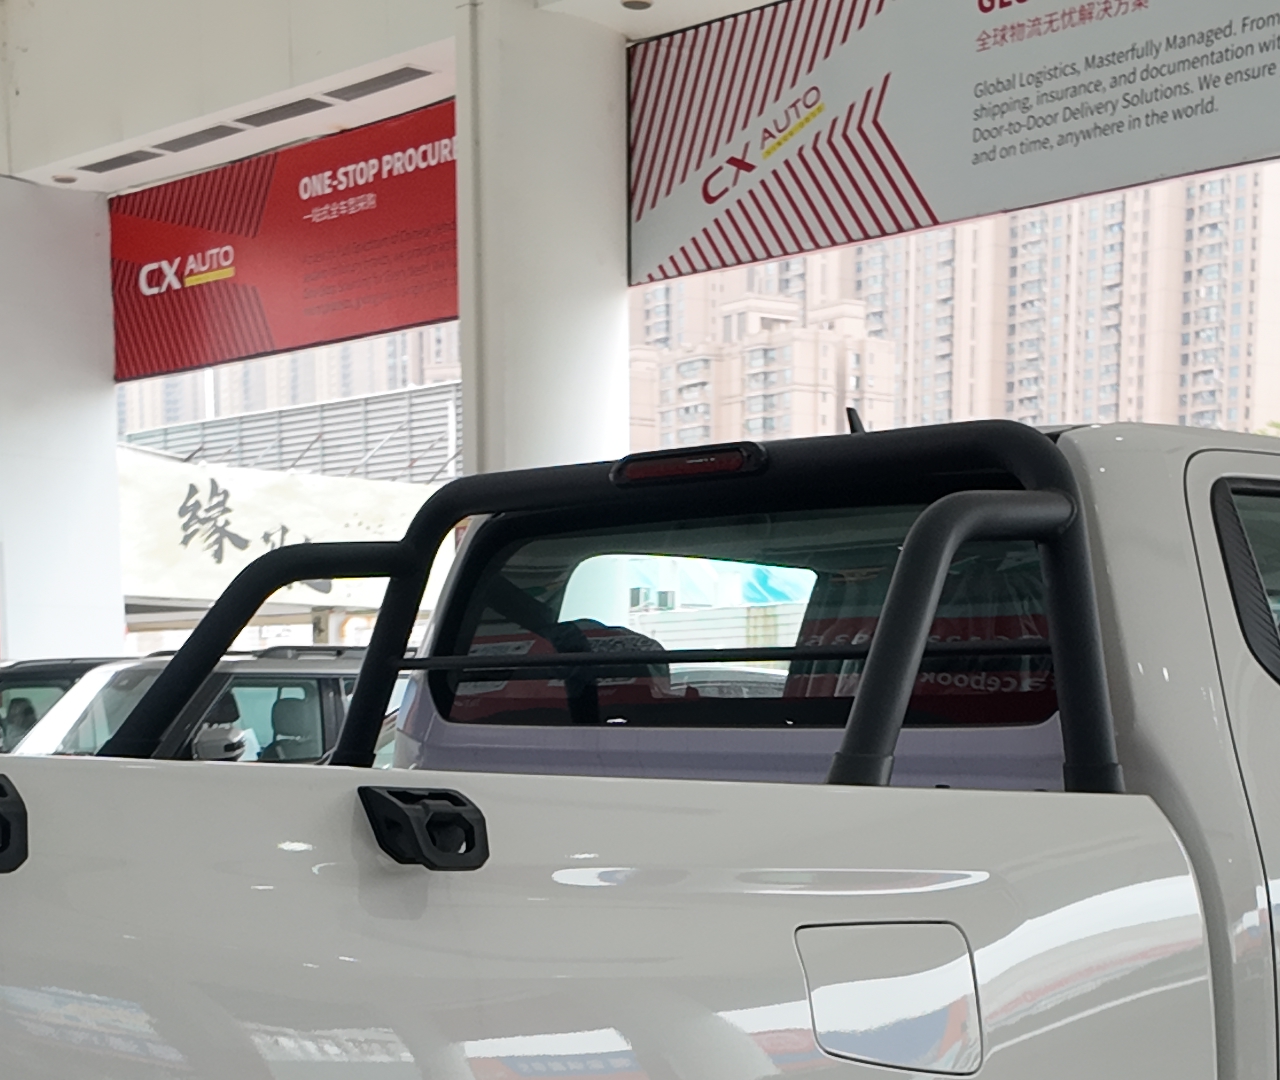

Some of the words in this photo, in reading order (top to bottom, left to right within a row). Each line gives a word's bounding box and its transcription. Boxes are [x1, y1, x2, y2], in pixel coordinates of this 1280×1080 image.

[972, 97, 1034, 122] shipping,
[1036, 78, 1107, 106] insurance,
[1109, 67, 1137, 90] and
[1139, 43, 1255, 82] documentation
[973, 73, 1017, 99] Global
[1019, 61, 1081, 89] Logistics,
[1084, 39, 1163, 72] Masterfully
[1165, 21, 1237, 51] Managed.
[1241, 10, 1280, 34] From
[971, 145, 997, 166] and
[998, 142, 1017, 160] on
[1019, 134, 1054, 156] time,
[1056, 118, 1125, 148] anywhere
[1127, 113, 1142, 131] in
[1144, 107, 1169, 129] the
[1171, 95, 1219, 121] world.
[972, 110, 1060, 144] Door-to-Door
[1062, 97, 1119, 124] Delivery
[1121, 81, 1194, 110] Solutions.
[1197, 72, 1221, 93] We
[1224, 60, 1277, 87] ensure
[298, 159, 380, 200] ONE-STOP
[702, 141, 757, 204] CX
[760, 86, 821, 150] AUTO
[138, 256, 182, 296] CX
[184, 245, 235, 276] AUTO
